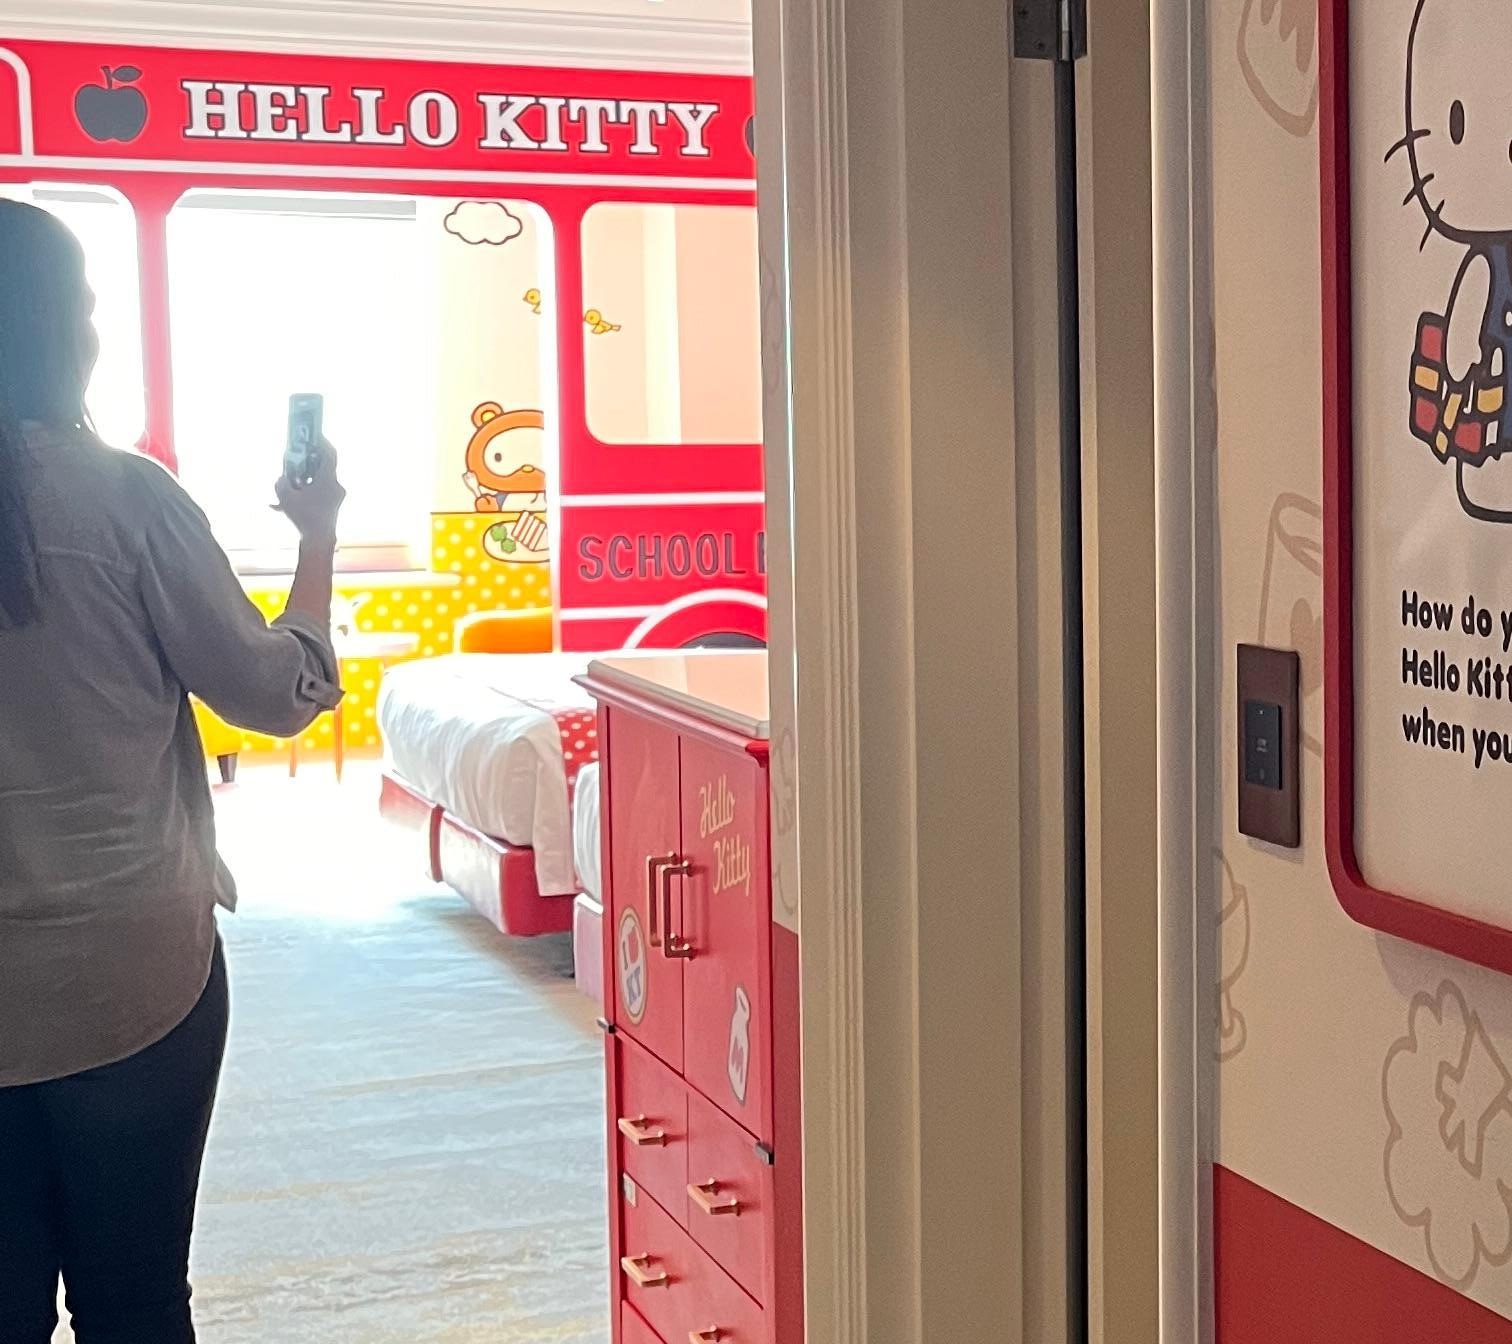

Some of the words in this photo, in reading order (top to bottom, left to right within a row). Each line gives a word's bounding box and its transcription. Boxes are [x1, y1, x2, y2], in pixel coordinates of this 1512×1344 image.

[180, 78, 460, 148] HELLO
[477, 91, 721, 157] KITTY
[579, 533, 746, 580] SCHOOL
[1400, 589, 1453, 632] How
[1461, 595, 1493, 638] do
[1400, 648, 1461, 694] Hello
[1401, 706, 1466, 755] when
[699, 773, 736, 840] Hello
[712, 834, 752, 897] Kitty
